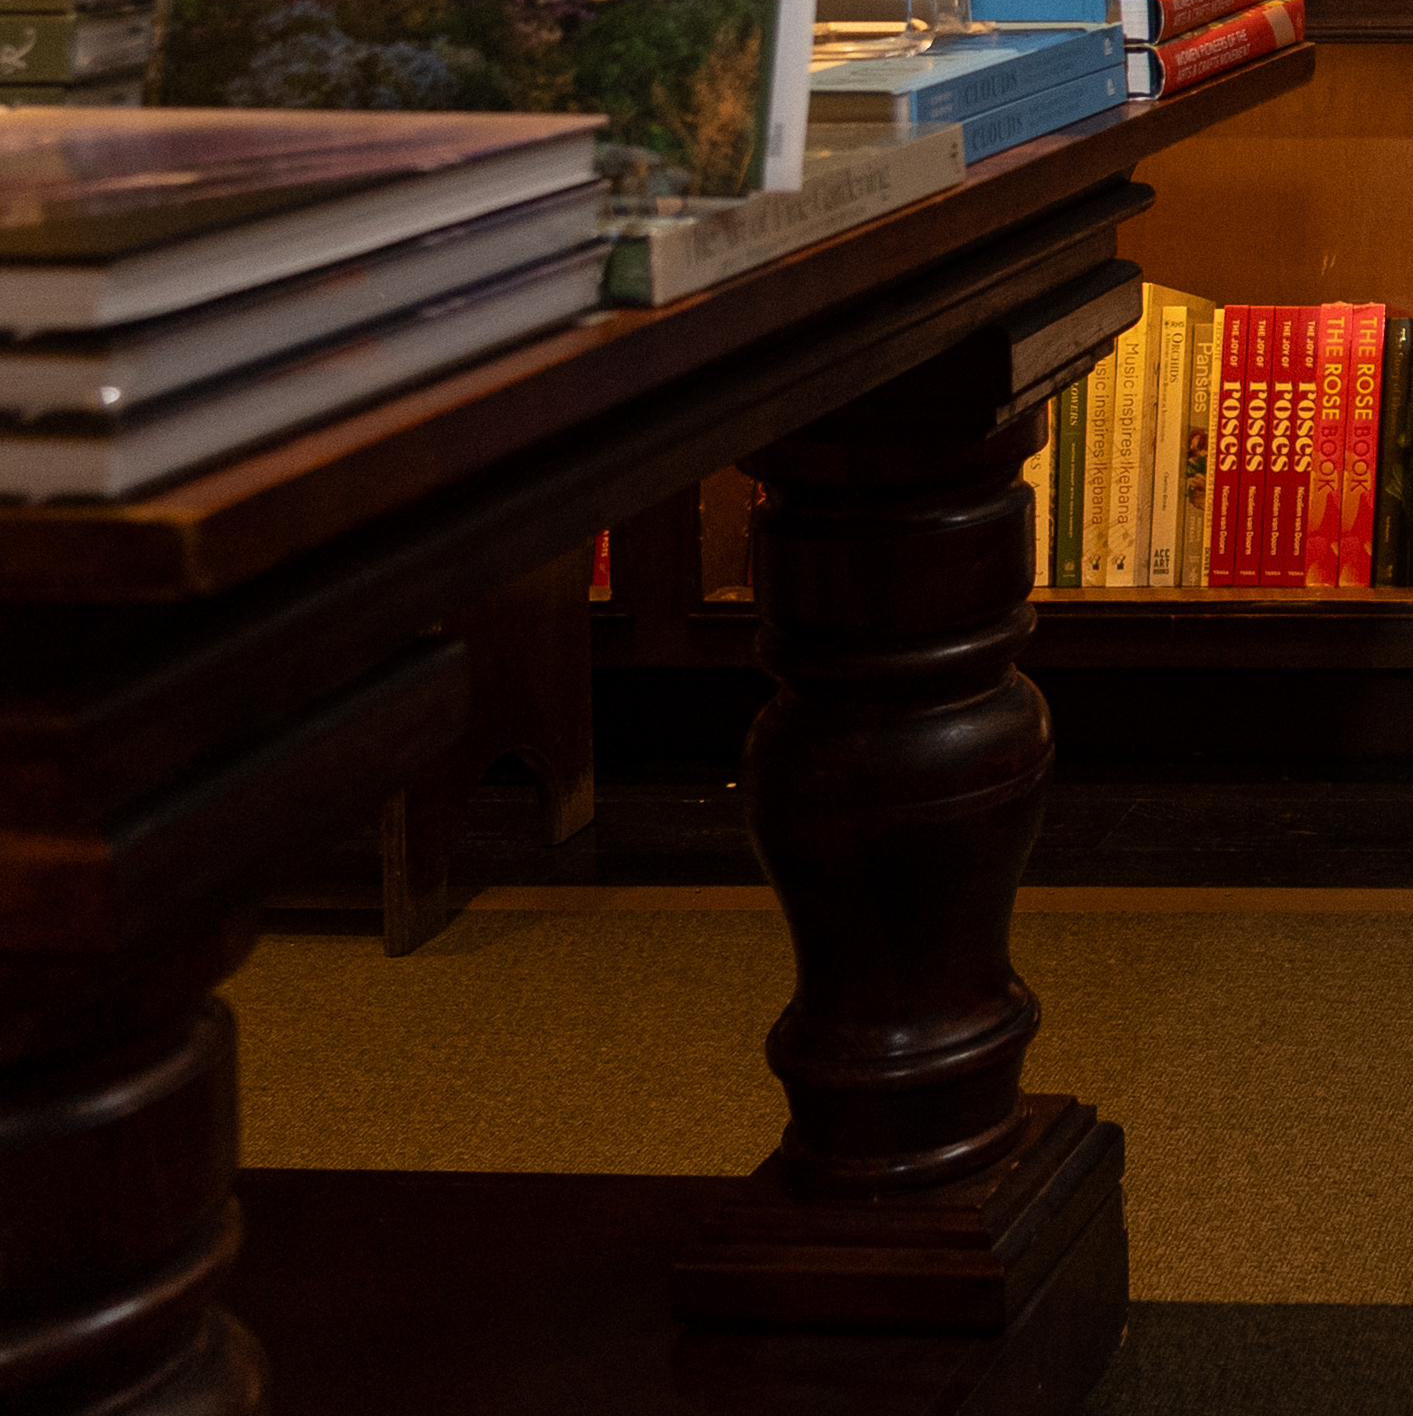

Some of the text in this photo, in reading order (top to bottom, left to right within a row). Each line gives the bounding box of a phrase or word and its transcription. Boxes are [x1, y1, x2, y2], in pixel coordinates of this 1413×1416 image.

[1170, 333, 1182, 383] ORCHIDS
[1194, 343, 1212, 412] Pansies
[1117, 343, 1139, 524] Music inspires Ikebana
[1294, 382, 1316, 472] roses
[1351, 318, 1377, 492] THE ROSE BOOK
